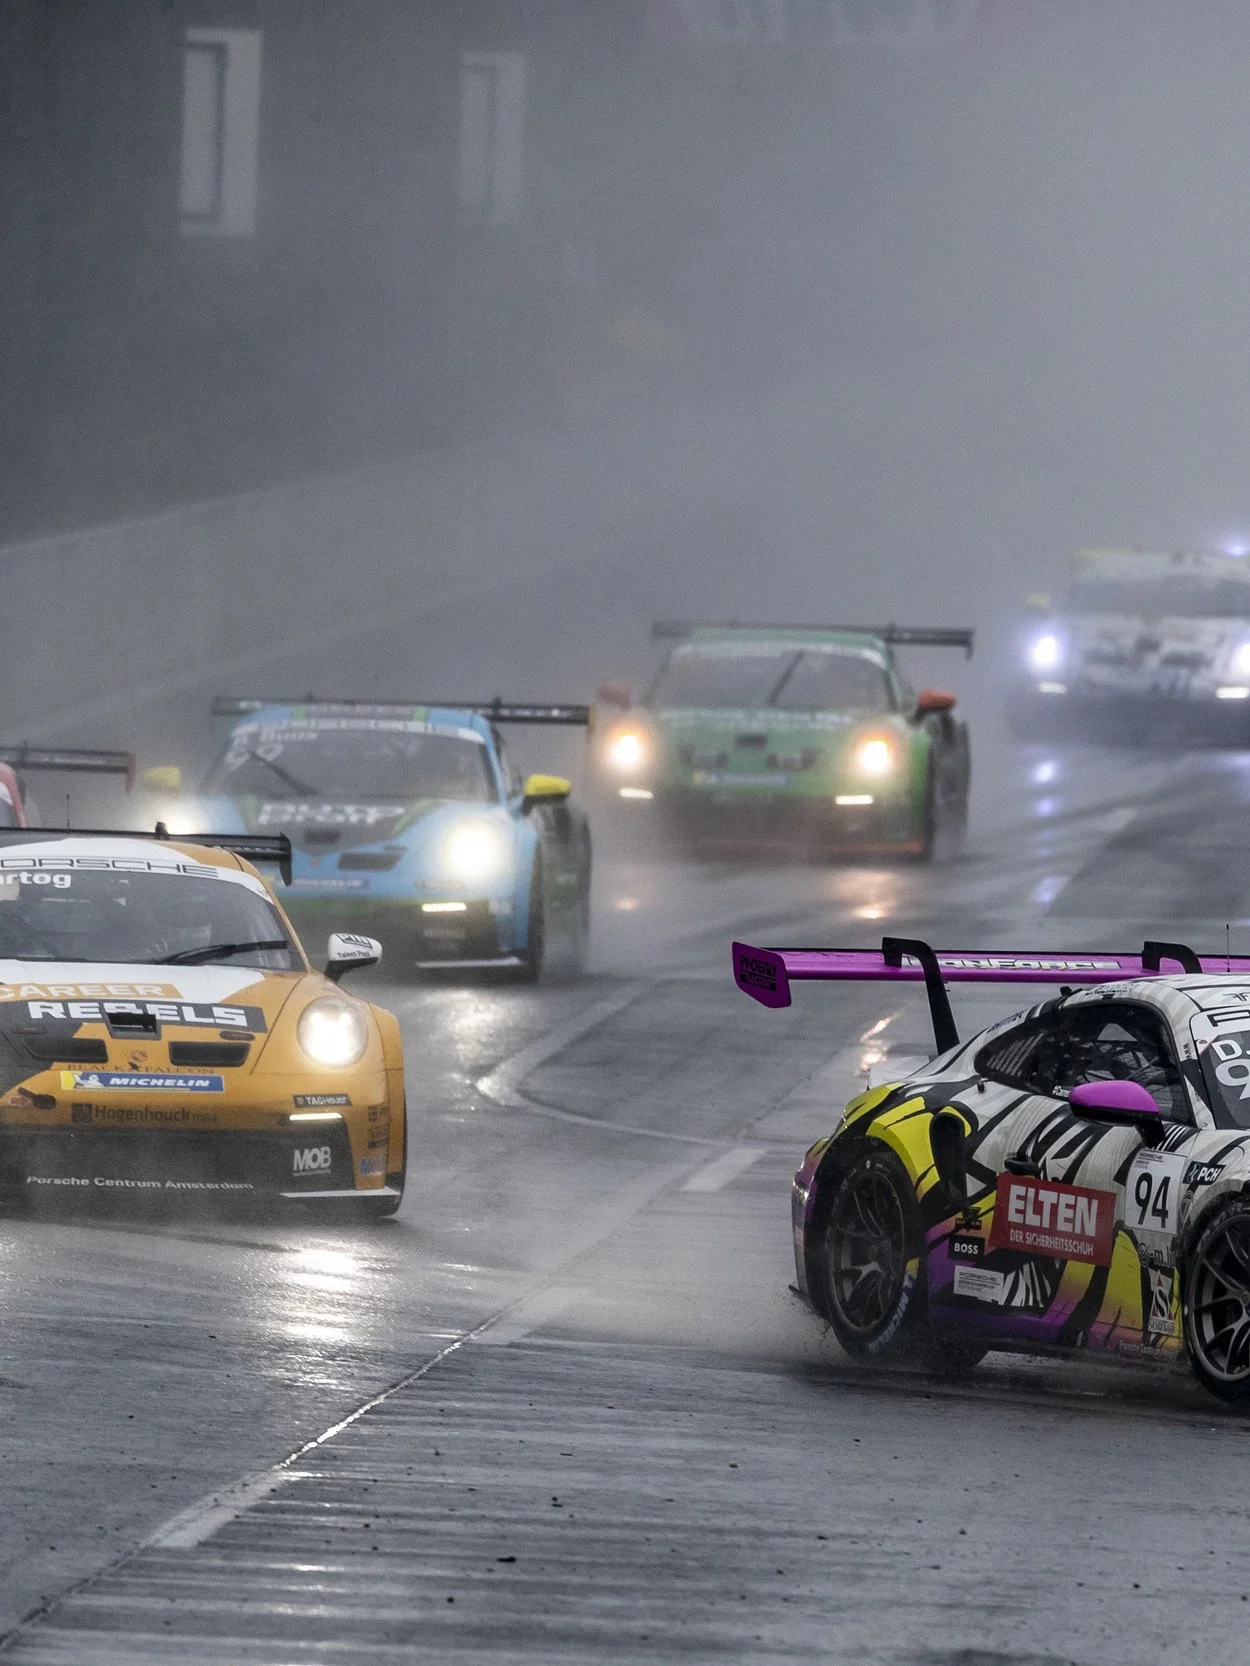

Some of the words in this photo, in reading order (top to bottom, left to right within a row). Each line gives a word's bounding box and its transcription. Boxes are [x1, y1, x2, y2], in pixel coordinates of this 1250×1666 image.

[0, 857, 219, 878] ORSCHE
[0, 984, 166, 1000] CAREER
[27, 1001, 248, 1027] REBELS
[110, 1077, 211, 1088] MICHELIN
[294, 1147, 331, 1171] MOB
[1200, 1167, 1221, 1182] PCH
[26, 1176, 90, 1187] Porsche
[94, 1178, 161, 1188] Centrum
[165, 1180, 254, 1190] Amsterdam
[1134, 1172, 1172, 1228] 94
[1008, 1184, 1099, 1237] ELTEN
[1010, 1228, 1025, 1244] DER
[954, 1242, 979, 1255] BOSS
